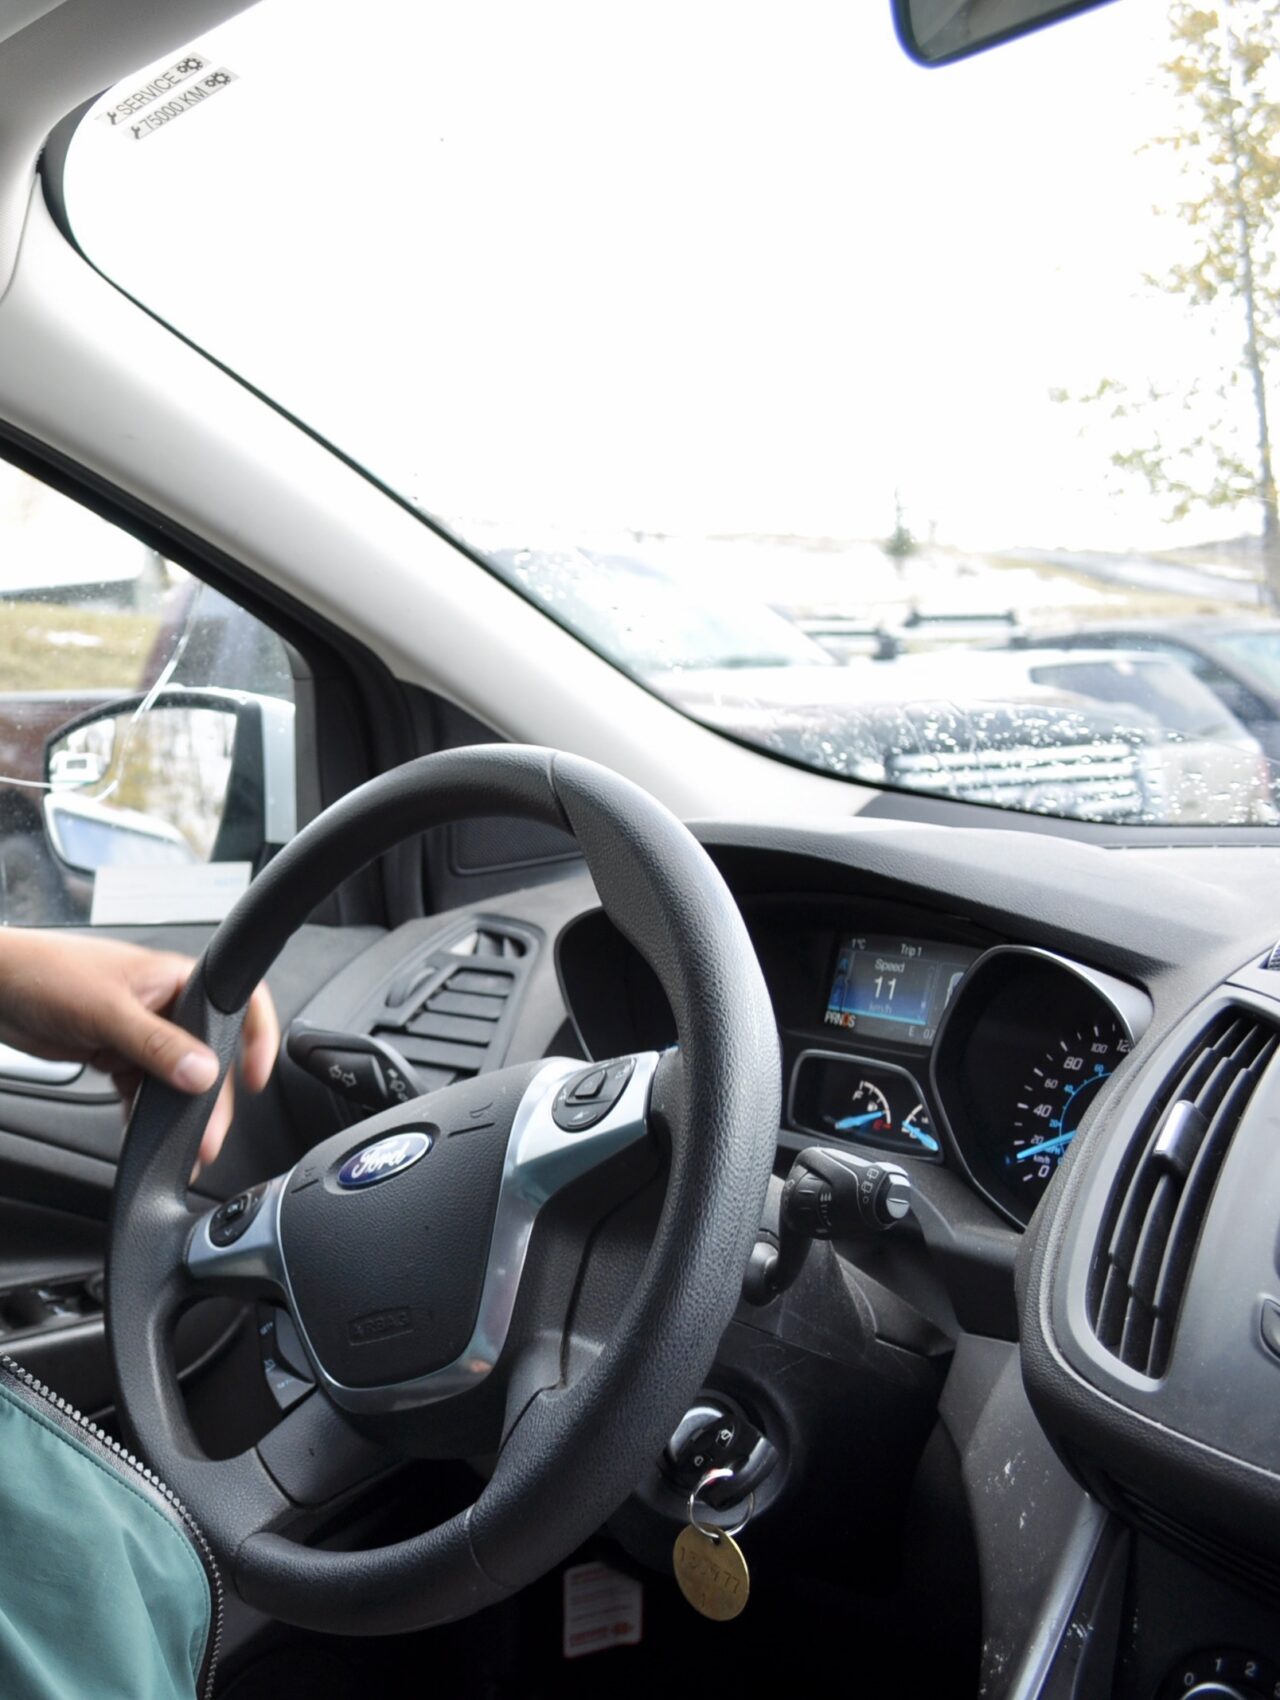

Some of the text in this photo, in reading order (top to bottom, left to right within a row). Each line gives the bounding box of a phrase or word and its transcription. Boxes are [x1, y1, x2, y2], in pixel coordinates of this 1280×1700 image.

[115, 71, 182, 116] SERVICE
[139, 86, 211, 131] 75000 KM
[900, 943, 917, 958] Trip
[874, 958, 905, 973] Speed
[874, 976, 897, 1000] 11
[1091, 1042, 1108, 1053] 100
[1063, 1056, 1083, 1070] 80
[1044, 1078, 1058, 1089] 60
[1033, 1104, 1052, 1118] 40
[350, 1140, 411, 1179] Ford
[1038, 1164, 1050, 1178] 0
[1183, 1672, 1194, 1686] 0
[1215, 1658, 1222, 1672] 1
[1244, 1661, 1256, 1677] 2
